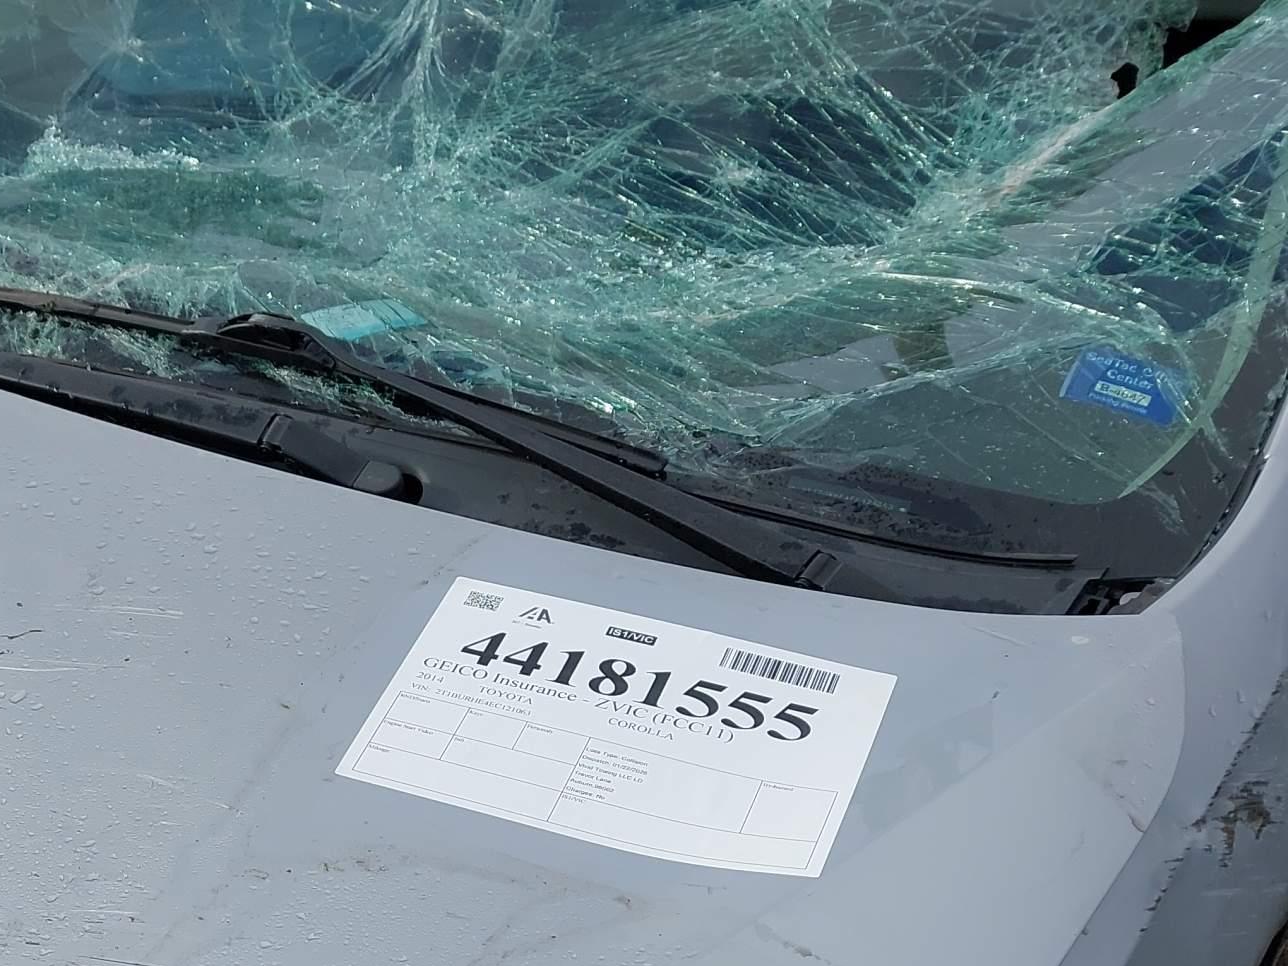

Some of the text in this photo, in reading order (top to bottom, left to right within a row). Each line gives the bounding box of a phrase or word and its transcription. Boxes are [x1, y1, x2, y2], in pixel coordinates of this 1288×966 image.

[1107, 369, 1153, 389] Center
[608, 627, 655, 645] IS1/VIC
[416, 671, 674, 741] 2014 TOYOTA COROLLA
[423, 657, 489, 680] GEICO
[493, 673, 577, 702] Insurance
[595, 698, 649, 720] ZVIC
[652, 709, 735, 744] (FCC11)
[460, 632, 819, 742] 44181555
